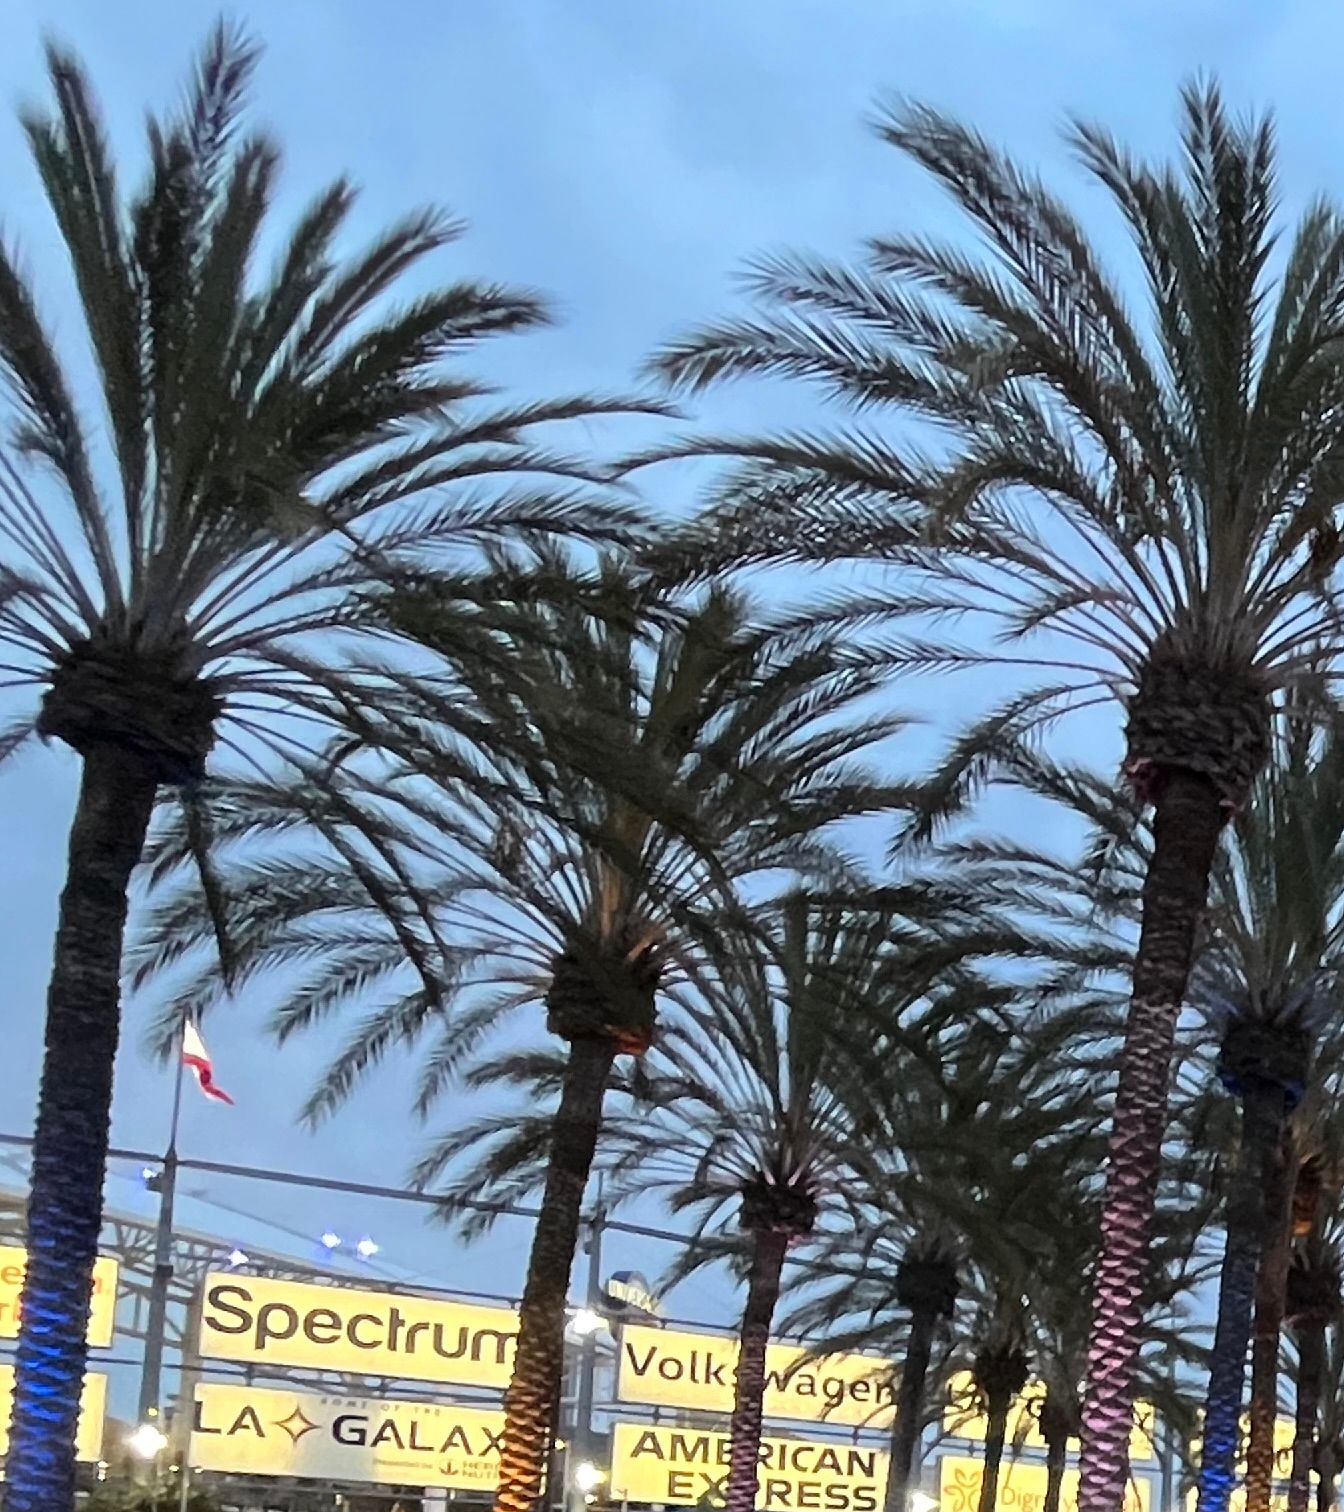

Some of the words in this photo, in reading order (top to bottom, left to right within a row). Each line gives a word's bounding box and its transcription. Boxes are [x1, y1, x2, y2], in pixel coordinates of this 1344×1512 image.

[204, 1285, 520, 1364] Spectrum
[194, 1400, 266, 1438] LA
[667, 1471, 877, 1512] EXRESS
